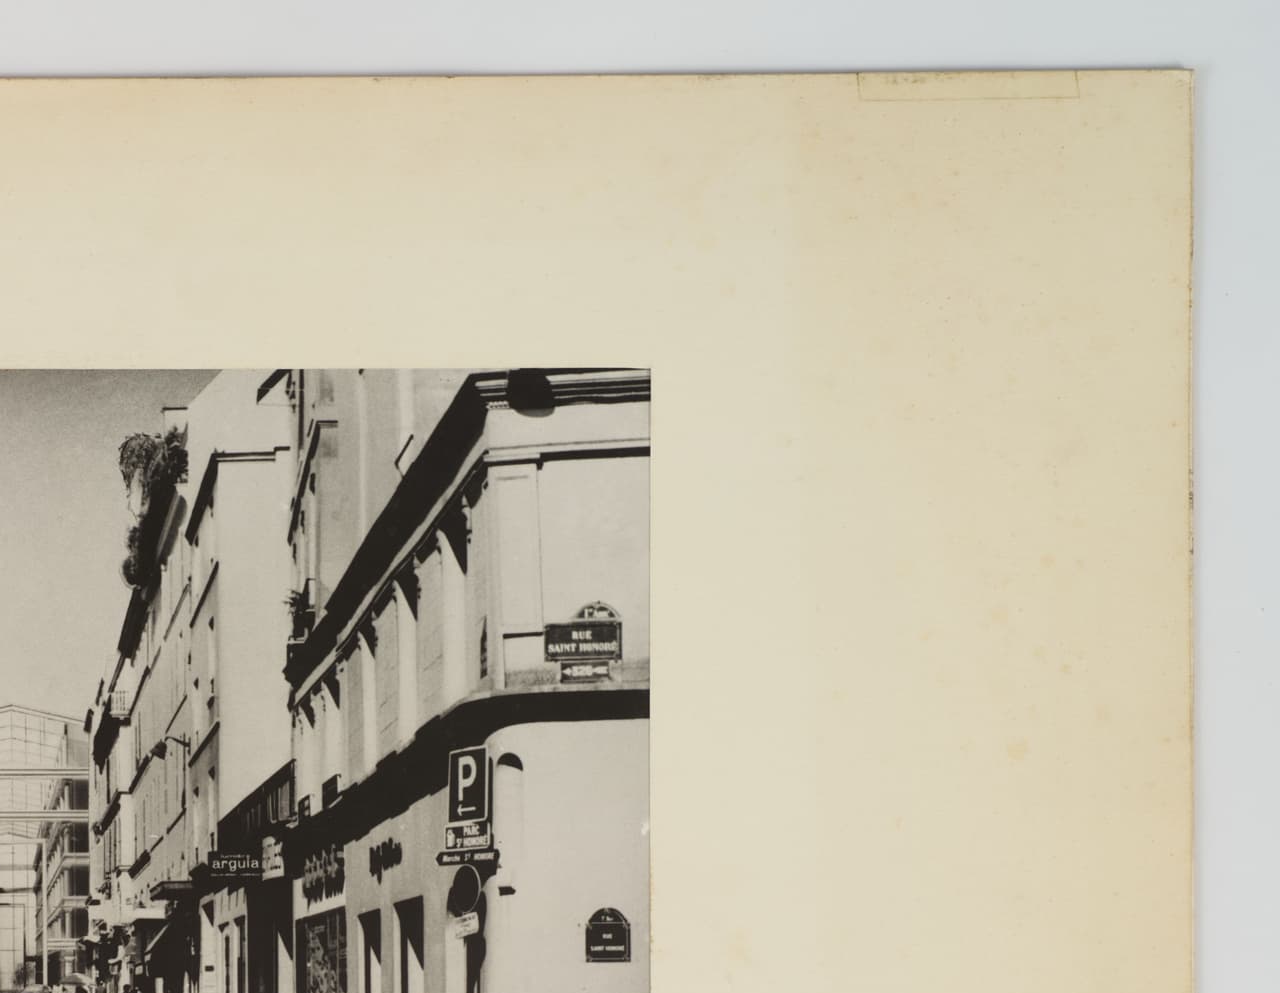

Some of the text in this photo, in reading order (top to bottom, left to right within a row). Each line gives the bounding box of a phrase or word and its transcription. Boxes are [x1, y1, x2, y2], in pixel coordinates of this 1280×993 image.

[571, 630, 593, 640] RUE
[547, 643, 577, 653] SAINT
[457, 755, 477, 801] P
